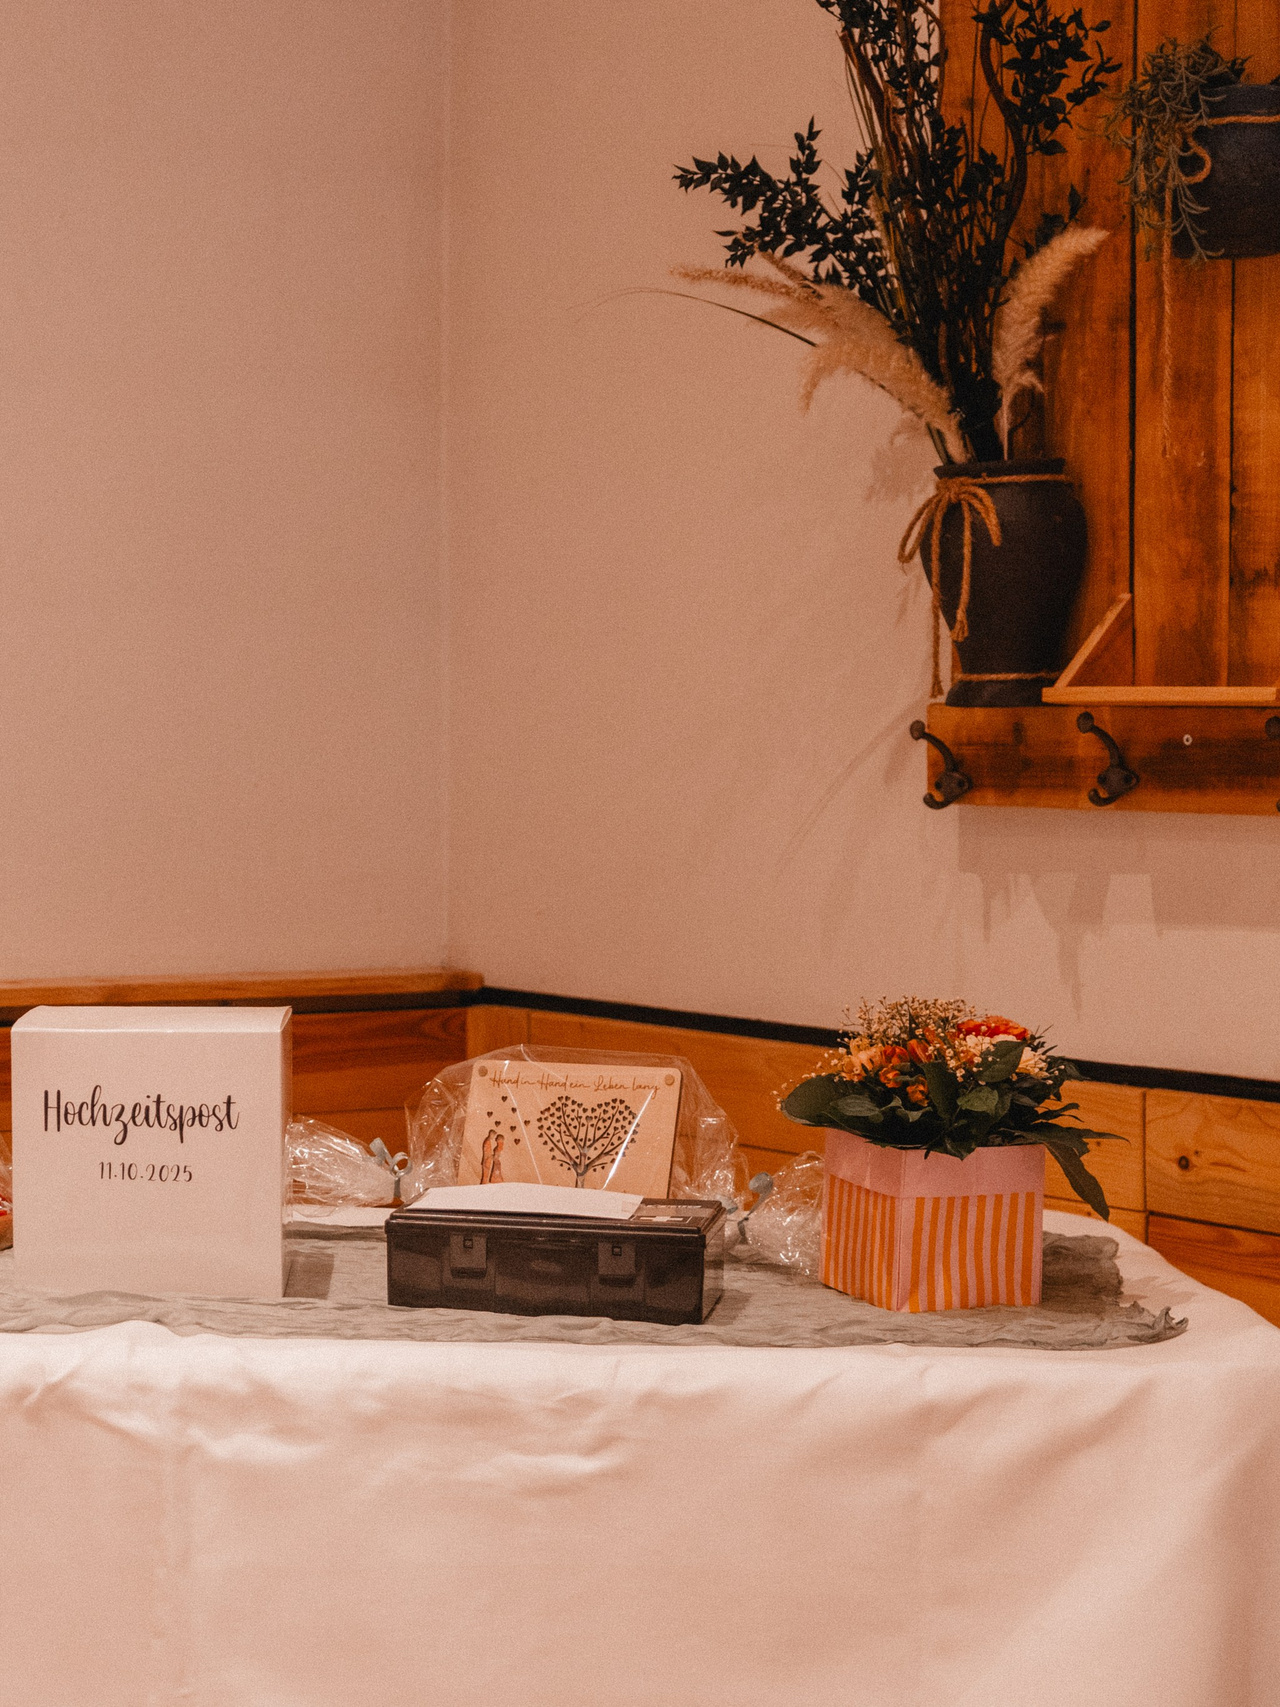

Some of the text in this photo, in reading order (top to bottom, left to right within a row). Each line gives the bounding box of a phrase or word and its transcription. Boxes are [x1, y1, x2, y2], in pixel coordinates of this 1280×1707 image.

[489, 1070, 660, 1099] Hand in Hand ein Leben lang
[43, 1084, 240, 1145] Hochzeitspost
[99, 1161, 193, 1183] 11.10.2025
